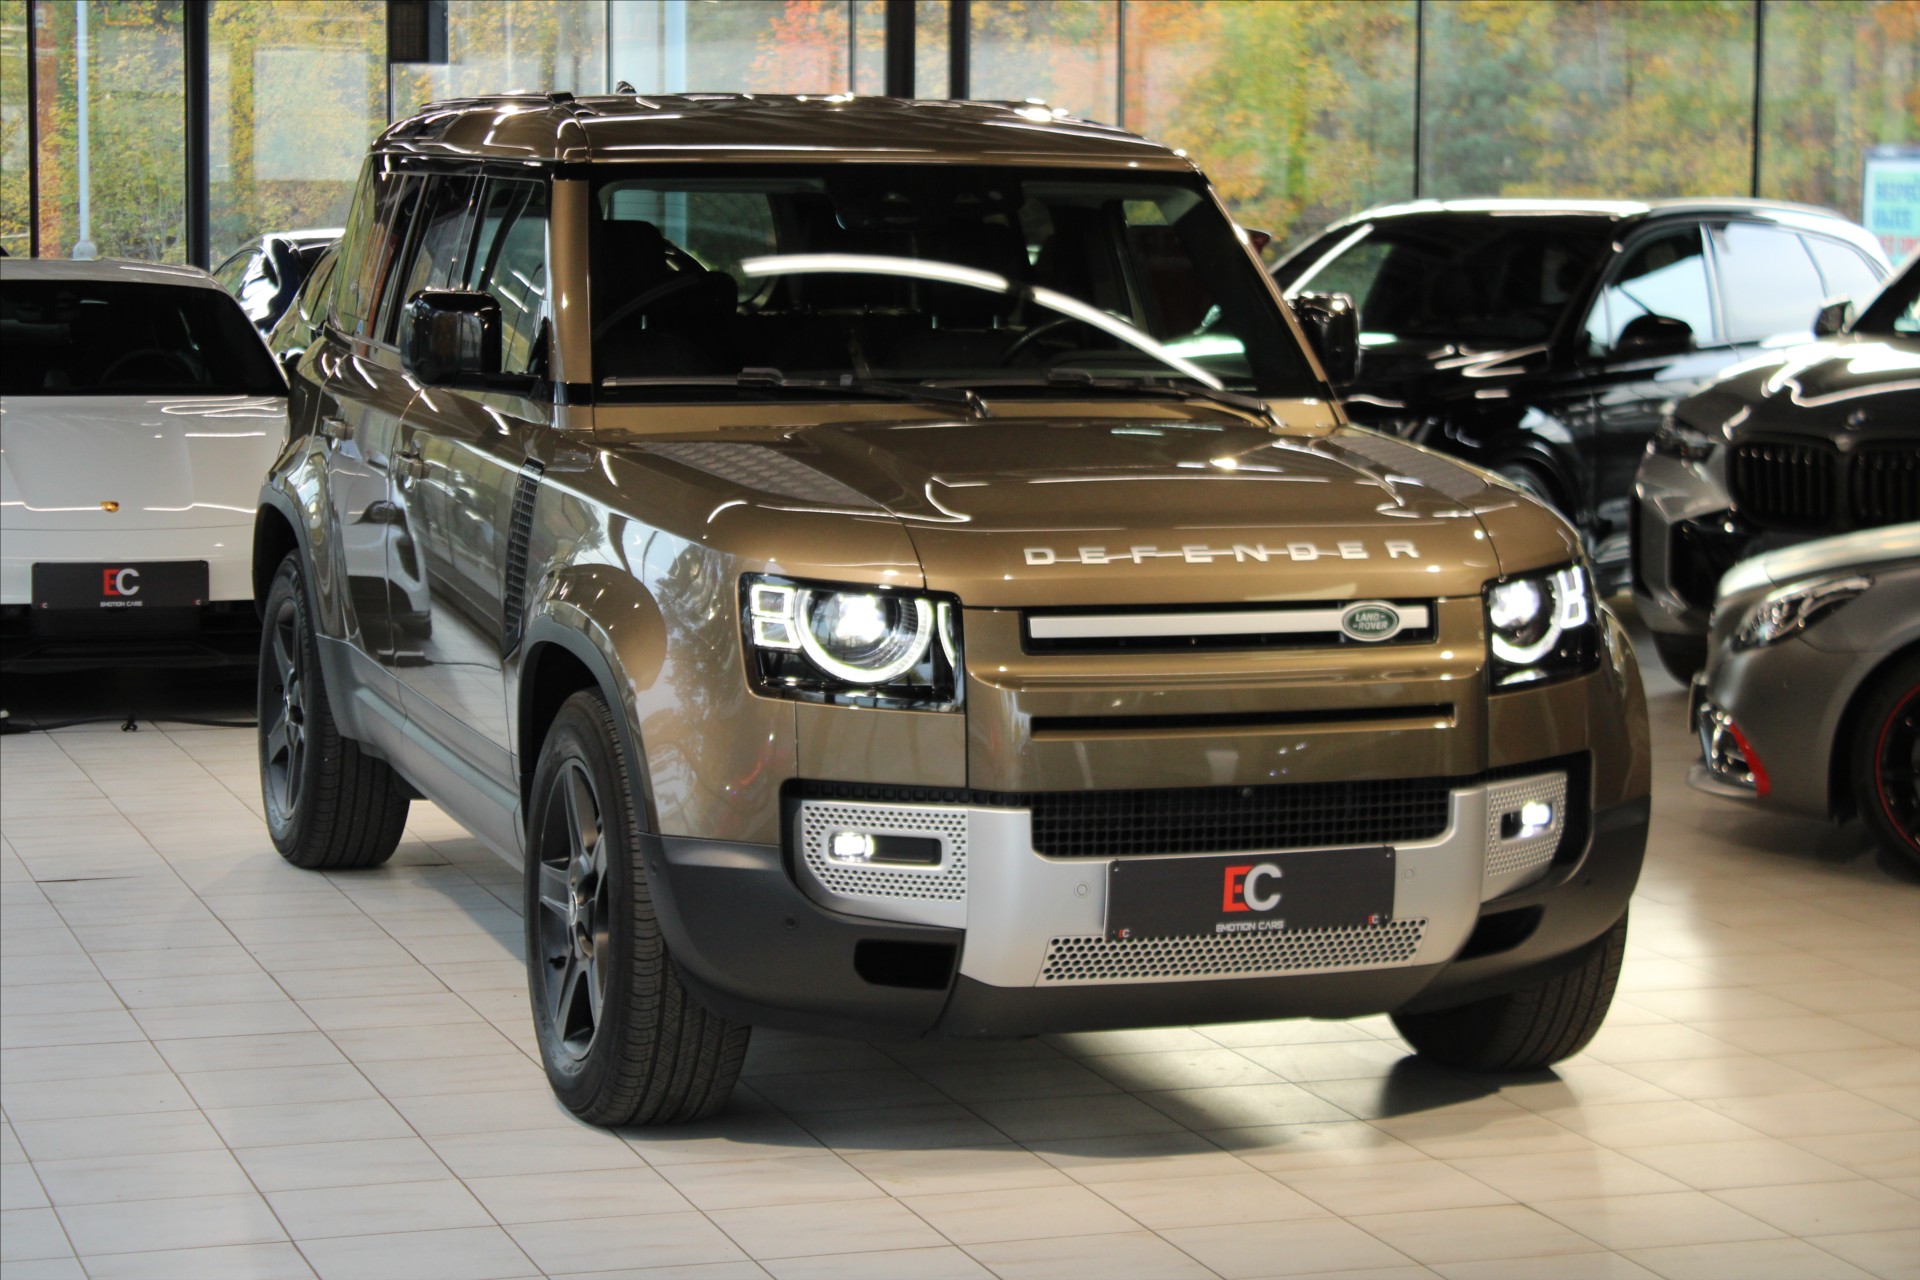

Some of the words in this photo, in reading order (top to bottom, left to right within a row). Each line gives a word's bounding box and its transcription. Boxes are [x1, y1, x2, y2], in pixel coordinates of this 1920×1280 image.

[1023, 540, 1420, 566] DEFENDER
[103, 568, 140, 596] EC
[1358, 621, 1388, 630] ROVER
[1222, 863, 1282, 912] EC
[1216, 922, 1256, 933] EMOTION
[1258, 920, 1284, 930] CARS
